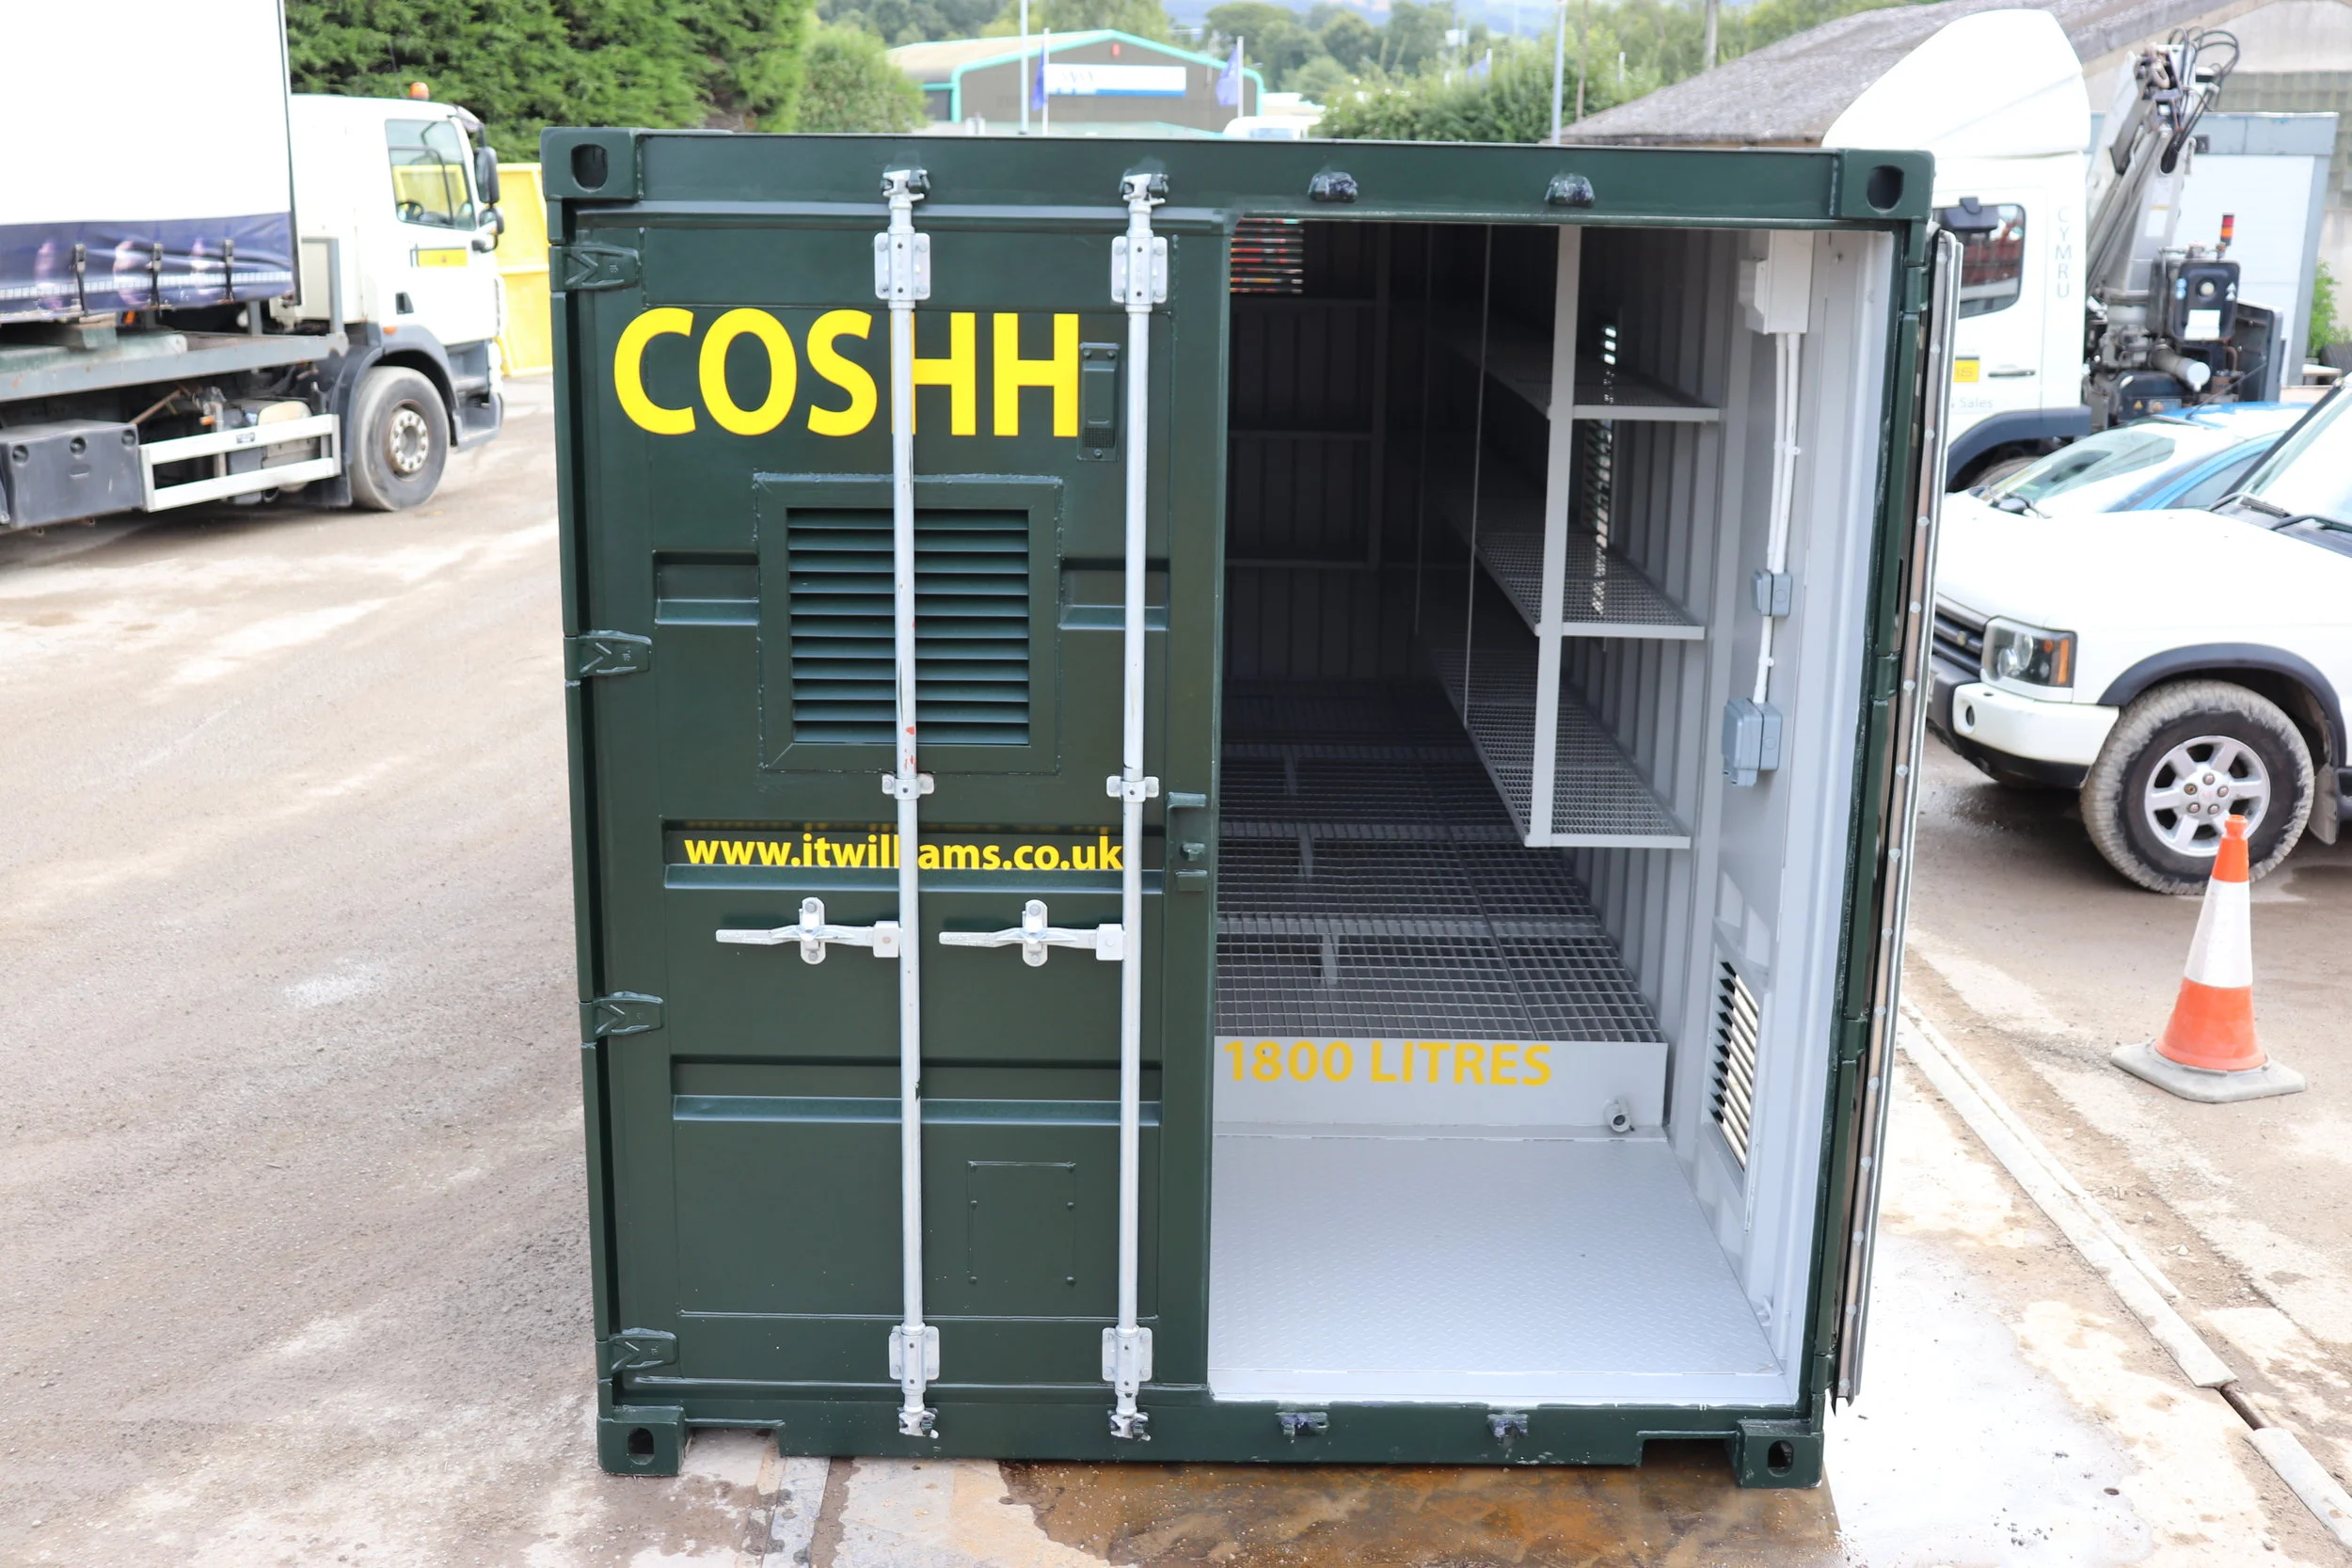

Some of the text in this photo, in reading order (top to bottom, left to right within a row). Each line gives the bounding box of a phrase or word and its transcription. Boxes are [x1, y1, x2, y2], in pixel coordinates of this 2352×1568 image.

[2055, 206, 2072, 298] CYMRU
[613, 307, 1079, 437] COSHH
[1960, 395, 1994, 409] Sales
[684, 833, 1124, 871] www.itwillams.co.uk
[1224, 1040, 1552, 1086] 1800 LITRES
